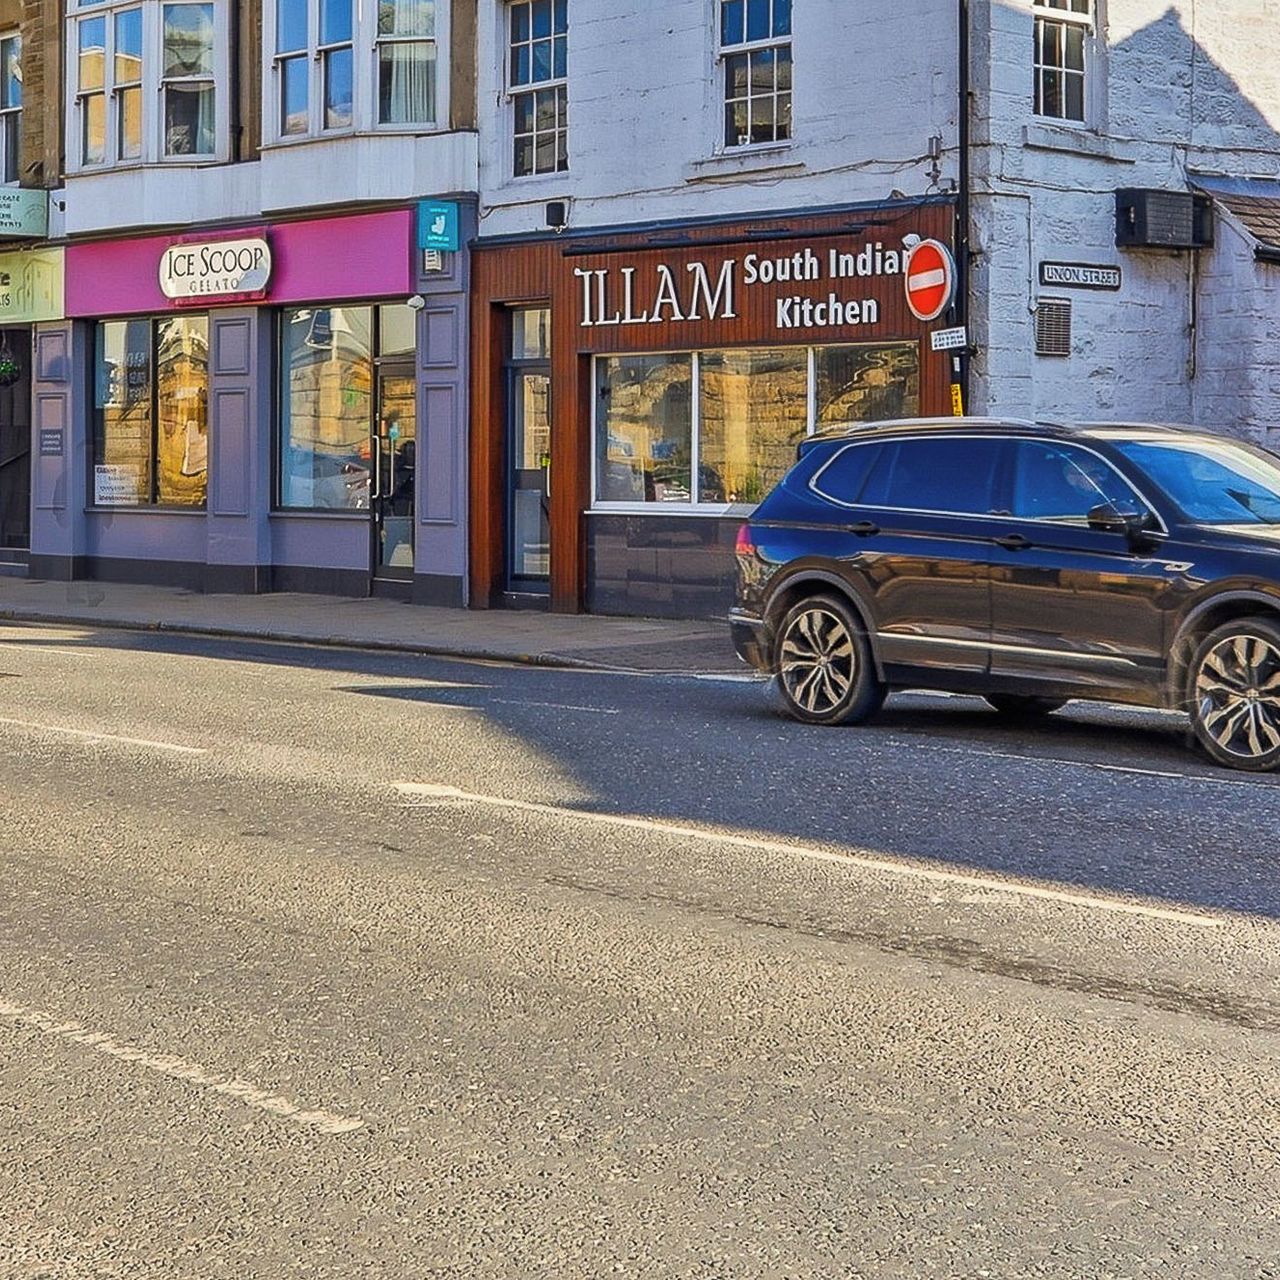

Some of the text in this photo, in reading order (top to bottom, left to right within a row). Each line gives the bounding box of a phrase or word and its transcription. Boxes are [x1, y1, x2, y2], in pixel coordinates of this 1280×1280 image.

[189, 278, 239, 293] GELATO
[574, 260, 736, 327] ILLAM
[744, 249, 818, 284] South
[1046, 267, 1118, 284] UNION STREET
[776, 294, 877, 328] Kitchen
